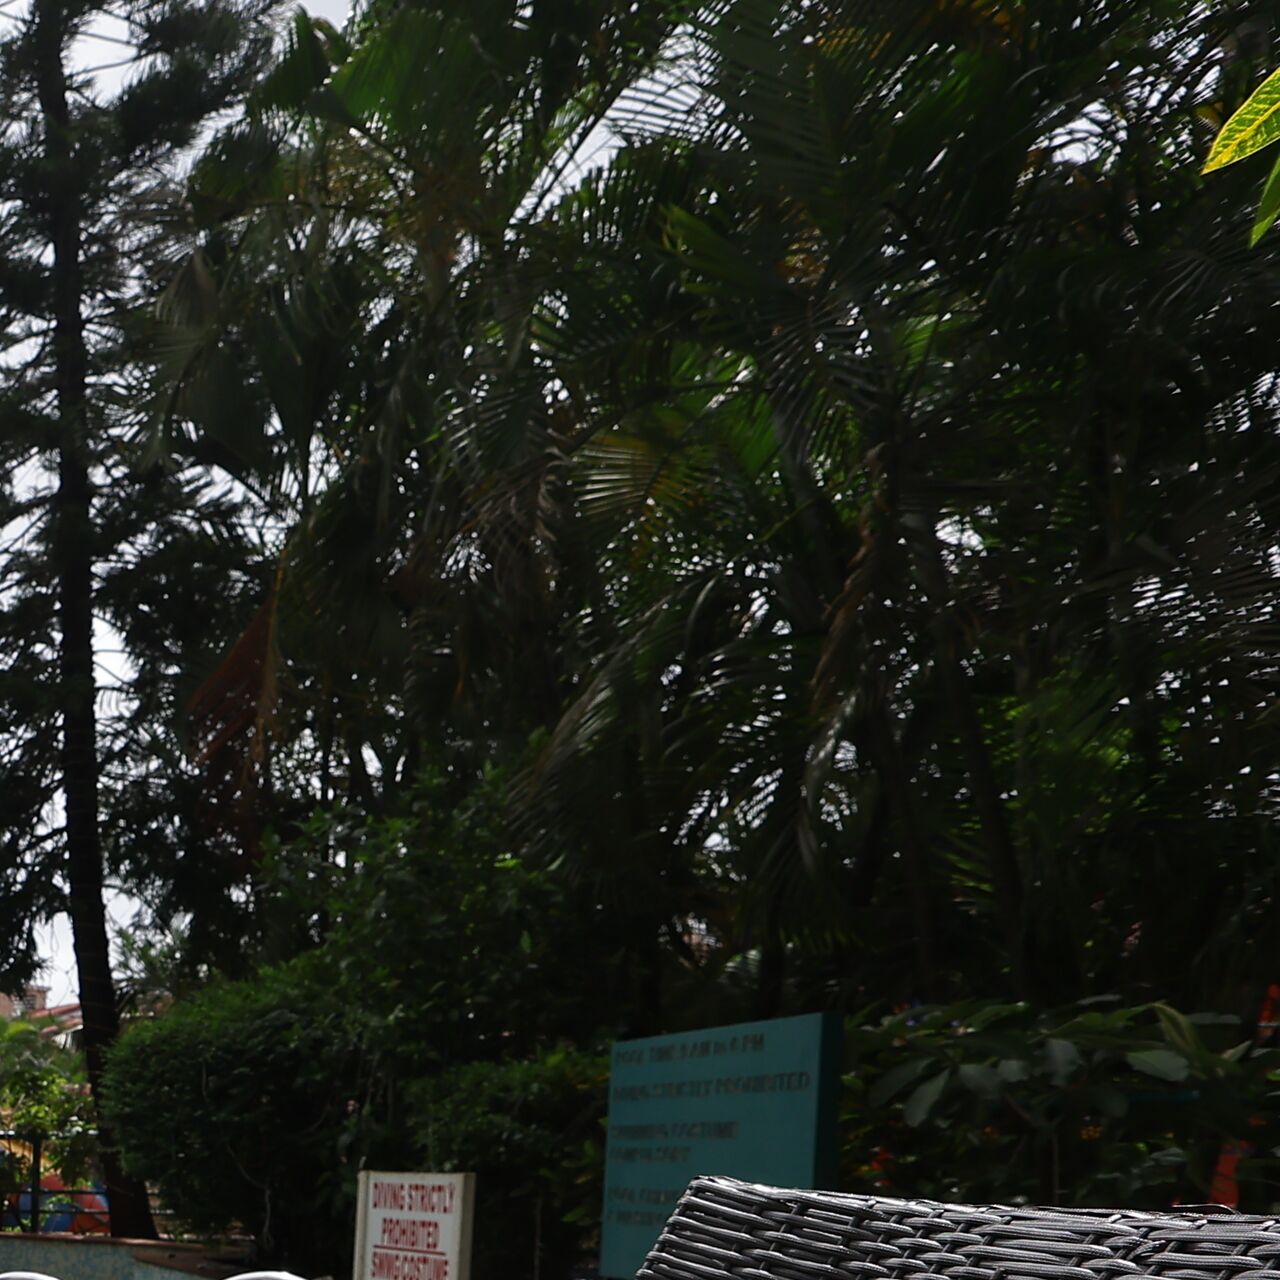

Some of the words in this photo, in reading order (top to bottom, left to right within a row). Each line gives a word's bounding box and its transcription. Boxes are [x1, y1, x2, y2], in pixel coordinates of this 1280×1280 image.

[715, 1070, 811, 1095] PROHIBITED
[372, 1181, 405, 1210] DIVING
[407, 1182, 456, 1214] STRICTLY
[380, 1217, 440, 1249] PROHIBITED
